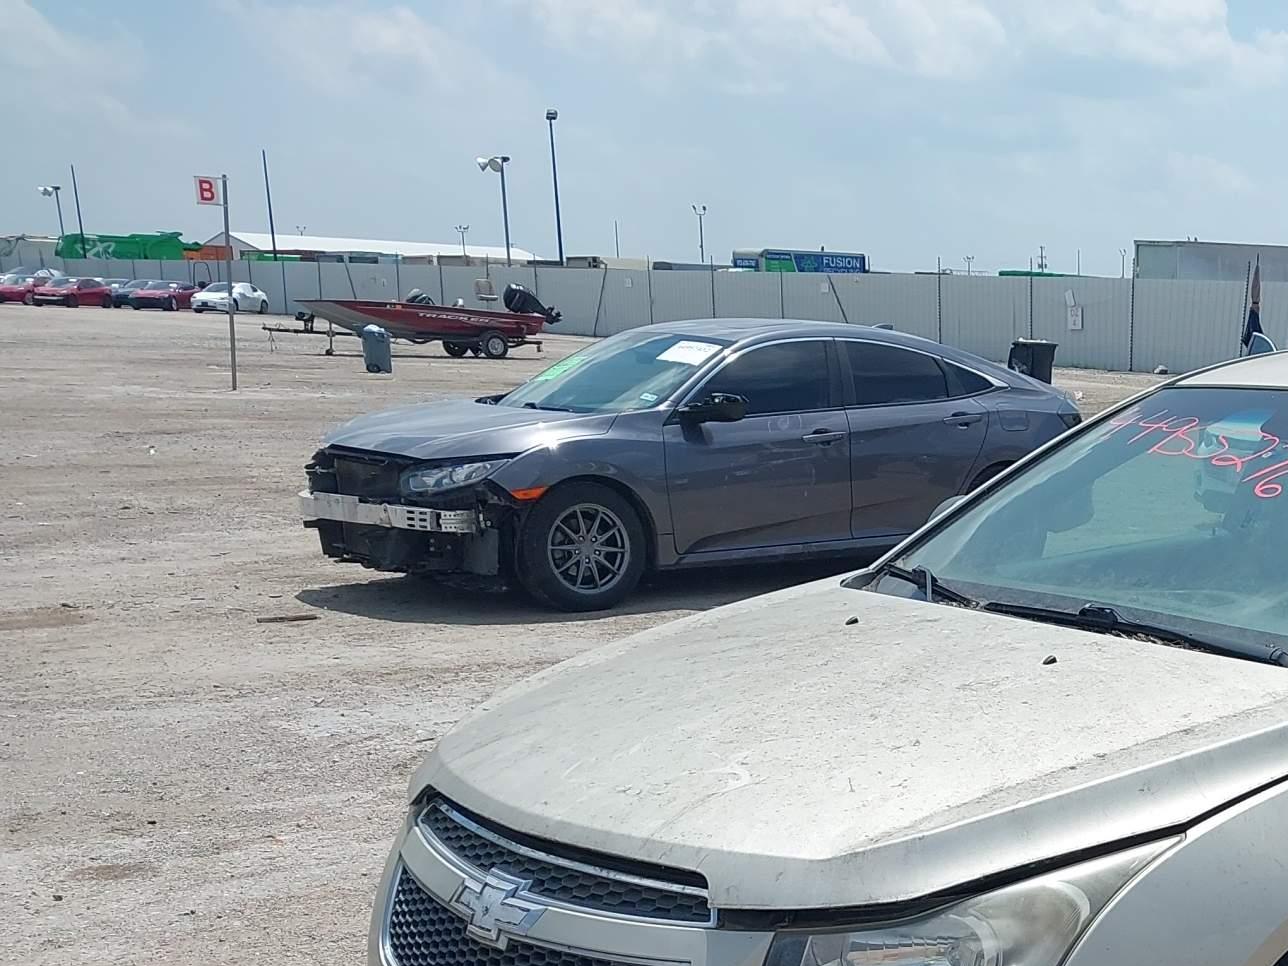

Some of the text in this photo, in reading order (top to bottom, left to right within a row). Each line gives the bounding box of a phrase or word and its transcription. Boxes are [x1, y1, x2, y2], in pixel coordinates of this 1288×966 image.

[199, 179, 215, 201] B
[823, 256, 860, 268] FUSION
[418, 312, 490, 323] TRACKER
